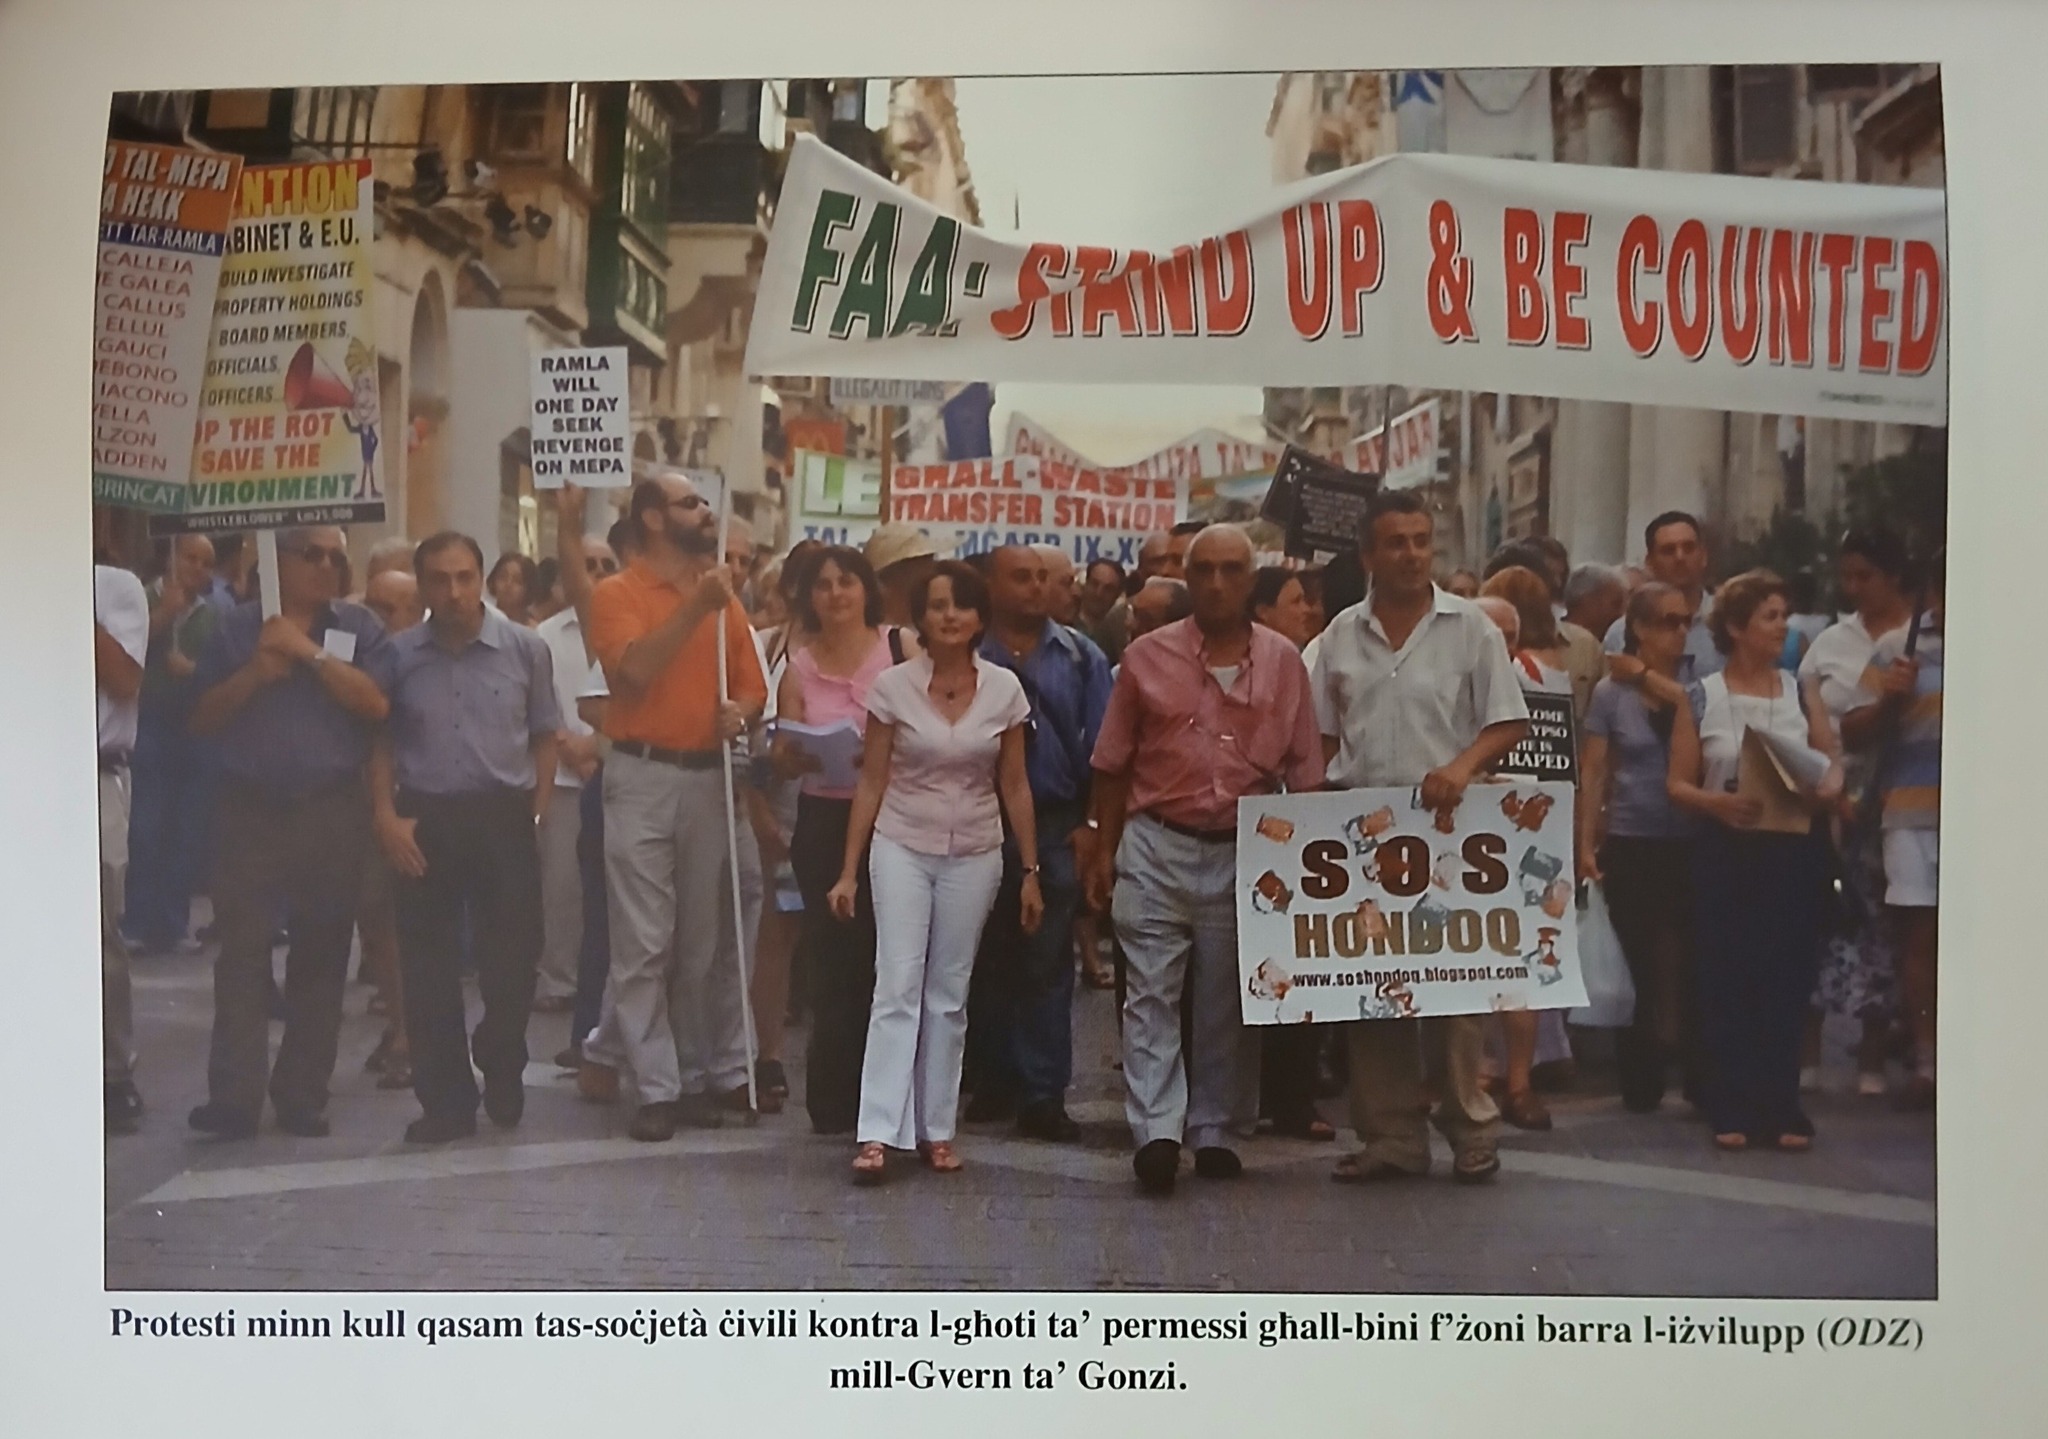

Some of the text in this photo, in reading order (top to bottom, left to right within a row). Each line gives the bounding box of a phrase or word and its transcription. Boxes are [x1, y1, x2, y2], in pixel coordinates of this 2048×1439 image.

[121, 148, 230, 191] TAL-MEPA
[120, 184, 184, 222] HEKK
[131, 223, 217, 250] TAR-RAMLA
[299, 220, 313, 249] &
[321, 217, 359, 247] E.U.
[102, 250, 193, 275] CALLEJA
[261, 261, 355, 284] INVESTIGATE
[120, 274, 190, 297] GALEA
[990, 230, 1254, 340] STAND
[1282, 199, 1384, 342] UP
[1428, 199, 1478, 343] &
[1504, 207, 1591, 351] BE
[1616, 214, 1943, 378] COUNTED
[288, 289, 363, 312] HOLDINGS
[106, 315, 169, 338] ELLUL
[219, 326, 269, 346] BOARD
[98, 338, 167, 360] GAUCI
[93, 358, 177, 384] EBONO
[541, 356, 610, 373] RAMLA
[553, 377, 600, 392] WILL
[535, 397, 618, 414] ONE DAY
[229, 415, 275, 441] THE
[285, 412, 336, 439] ROT
[552, 417, 603, 433] SEEK
[533, 437, 624, 454] REVENGE
[201, 443, 321, 475] SAVE THE
[535, 458, 624, 475] ON MEPA
[893, 491, 1176, 532] TRANSFER STATION
[1508, 751, 1570, 770] RAPED
[1293, 908, 1523, 959] HONDOQ
[1293, 966, 1529, 987] www.soshondoq.blogspot.com
[111, 1309, 235, 1337] Protesti
[248, 1309, 330, 1337] minn
[343, 1310, 405, 1337] kull
[418, 1318, 522, 1345] qasam
[536, 1308, 707, 1344] tas-soċjetà
[719, 1309, 797, 1337] ċivili
[809, 1309, 918, 1337] kontra
[930, 1310, 1035, 1345] l-għoti
[1103, 1311, 1247, 1346] permessi
[1259, 1312, 1418, 1347] għall-bini
[1537, 1314, 1632, 1343] barra
[1644, 1315, 1804, 1353] l-iżvilupp
[1817, 1317, 1925, 1352] (ODZ)
[830, 1360, 1011, 1389] mill-Gvern
[1079, 1361, 1187, 1390] Gonzi.
